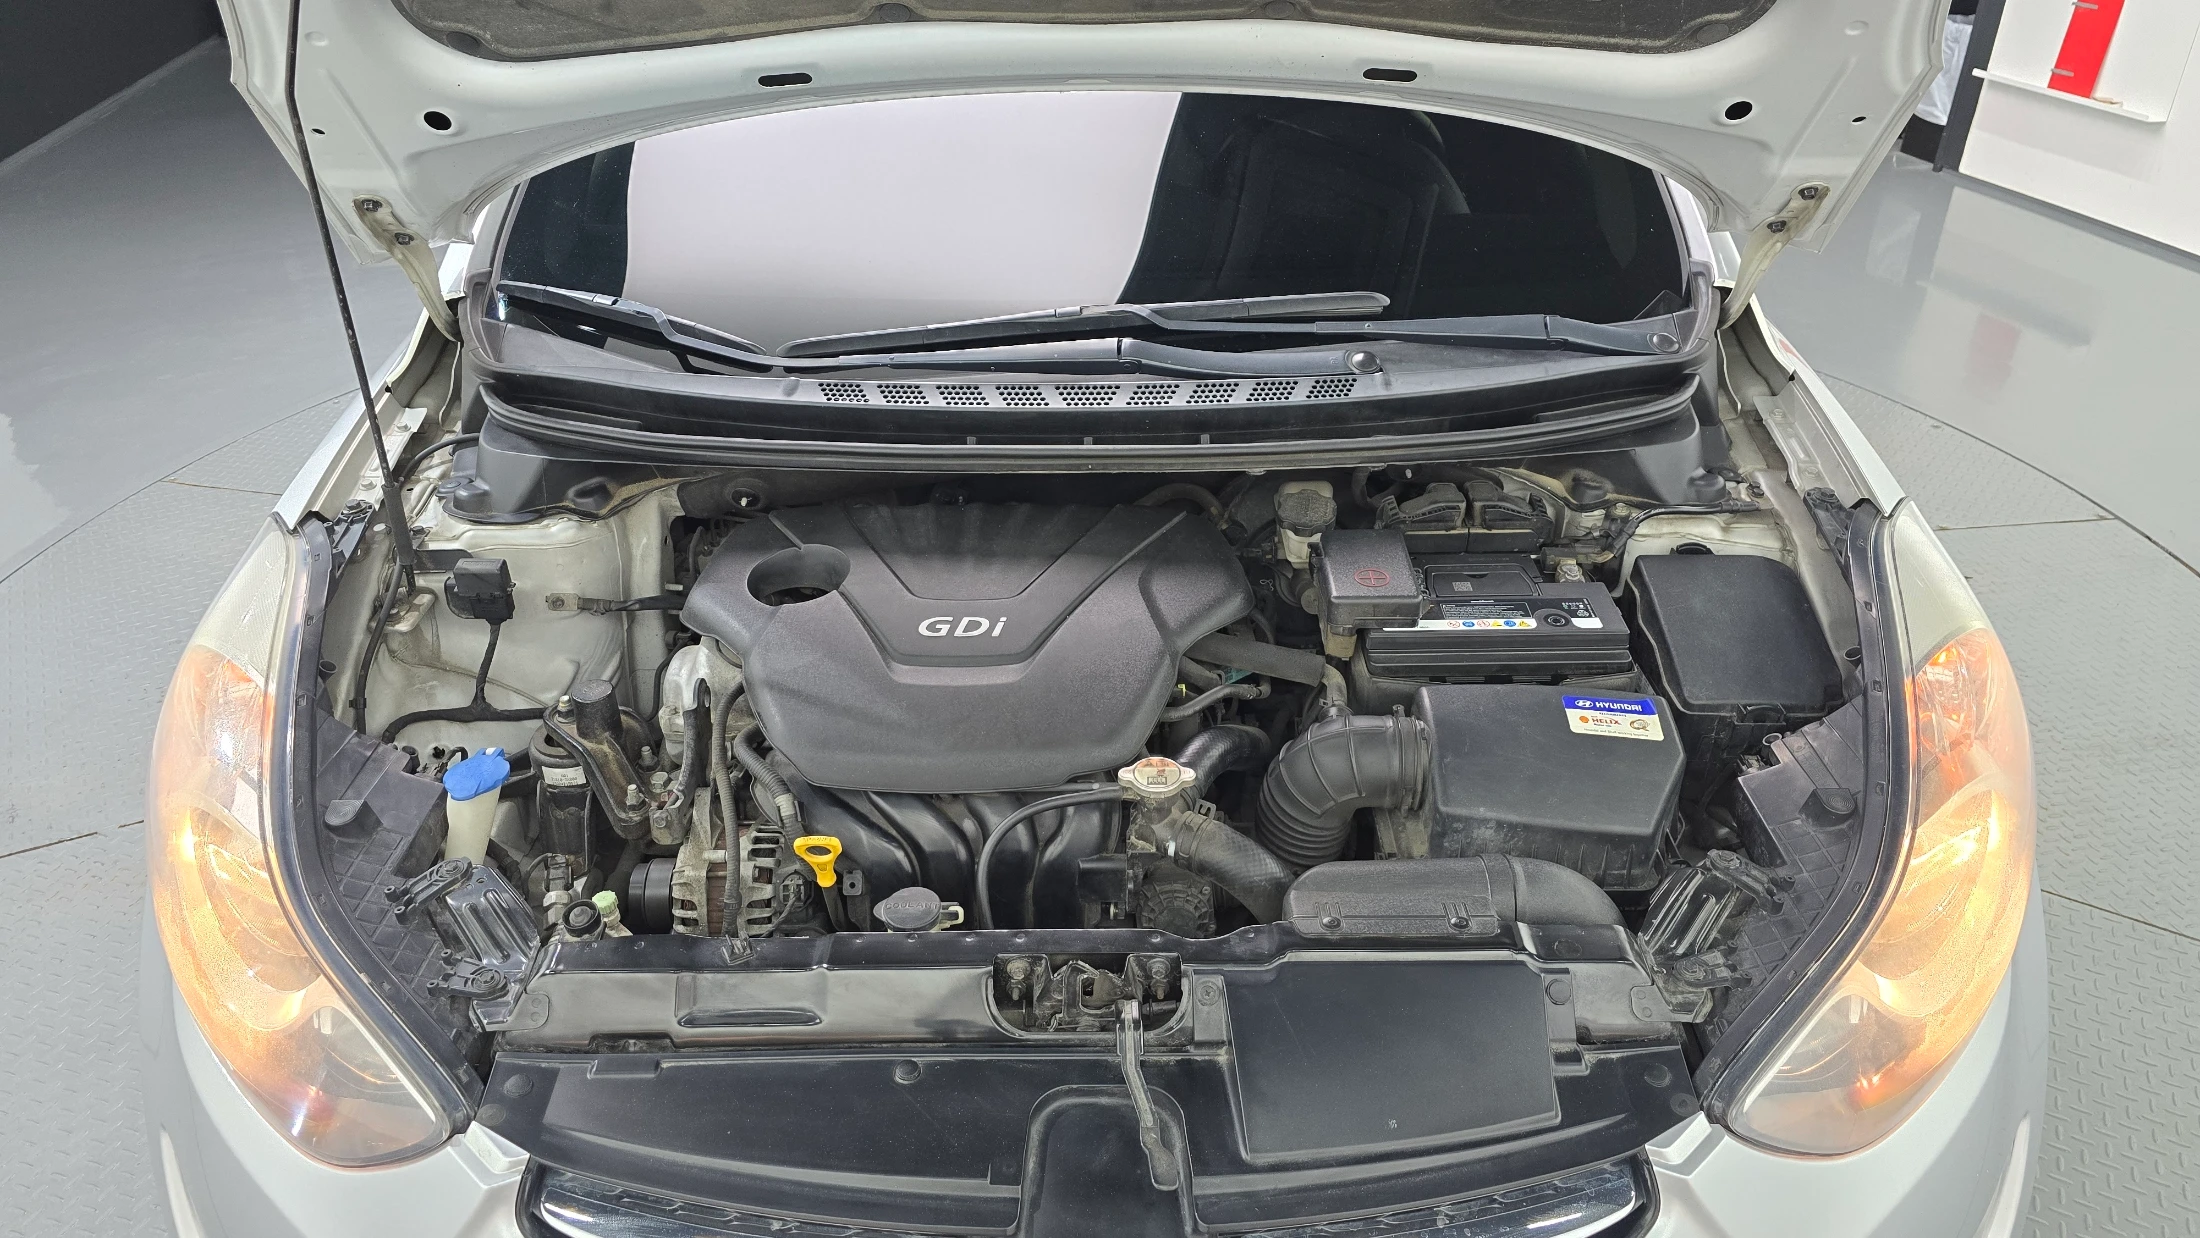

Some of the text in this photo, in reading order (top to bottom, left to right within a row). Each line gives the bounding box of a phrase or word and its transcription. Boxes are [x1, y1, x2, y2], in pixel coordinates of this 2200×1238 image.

[918, 616, 1007, 637] GDi
[1595, 701, 1642, 712] HYUNDAI
[1592, 717, 1621, 726] HELIX
[885, 901, 940, 910] COOLANT
